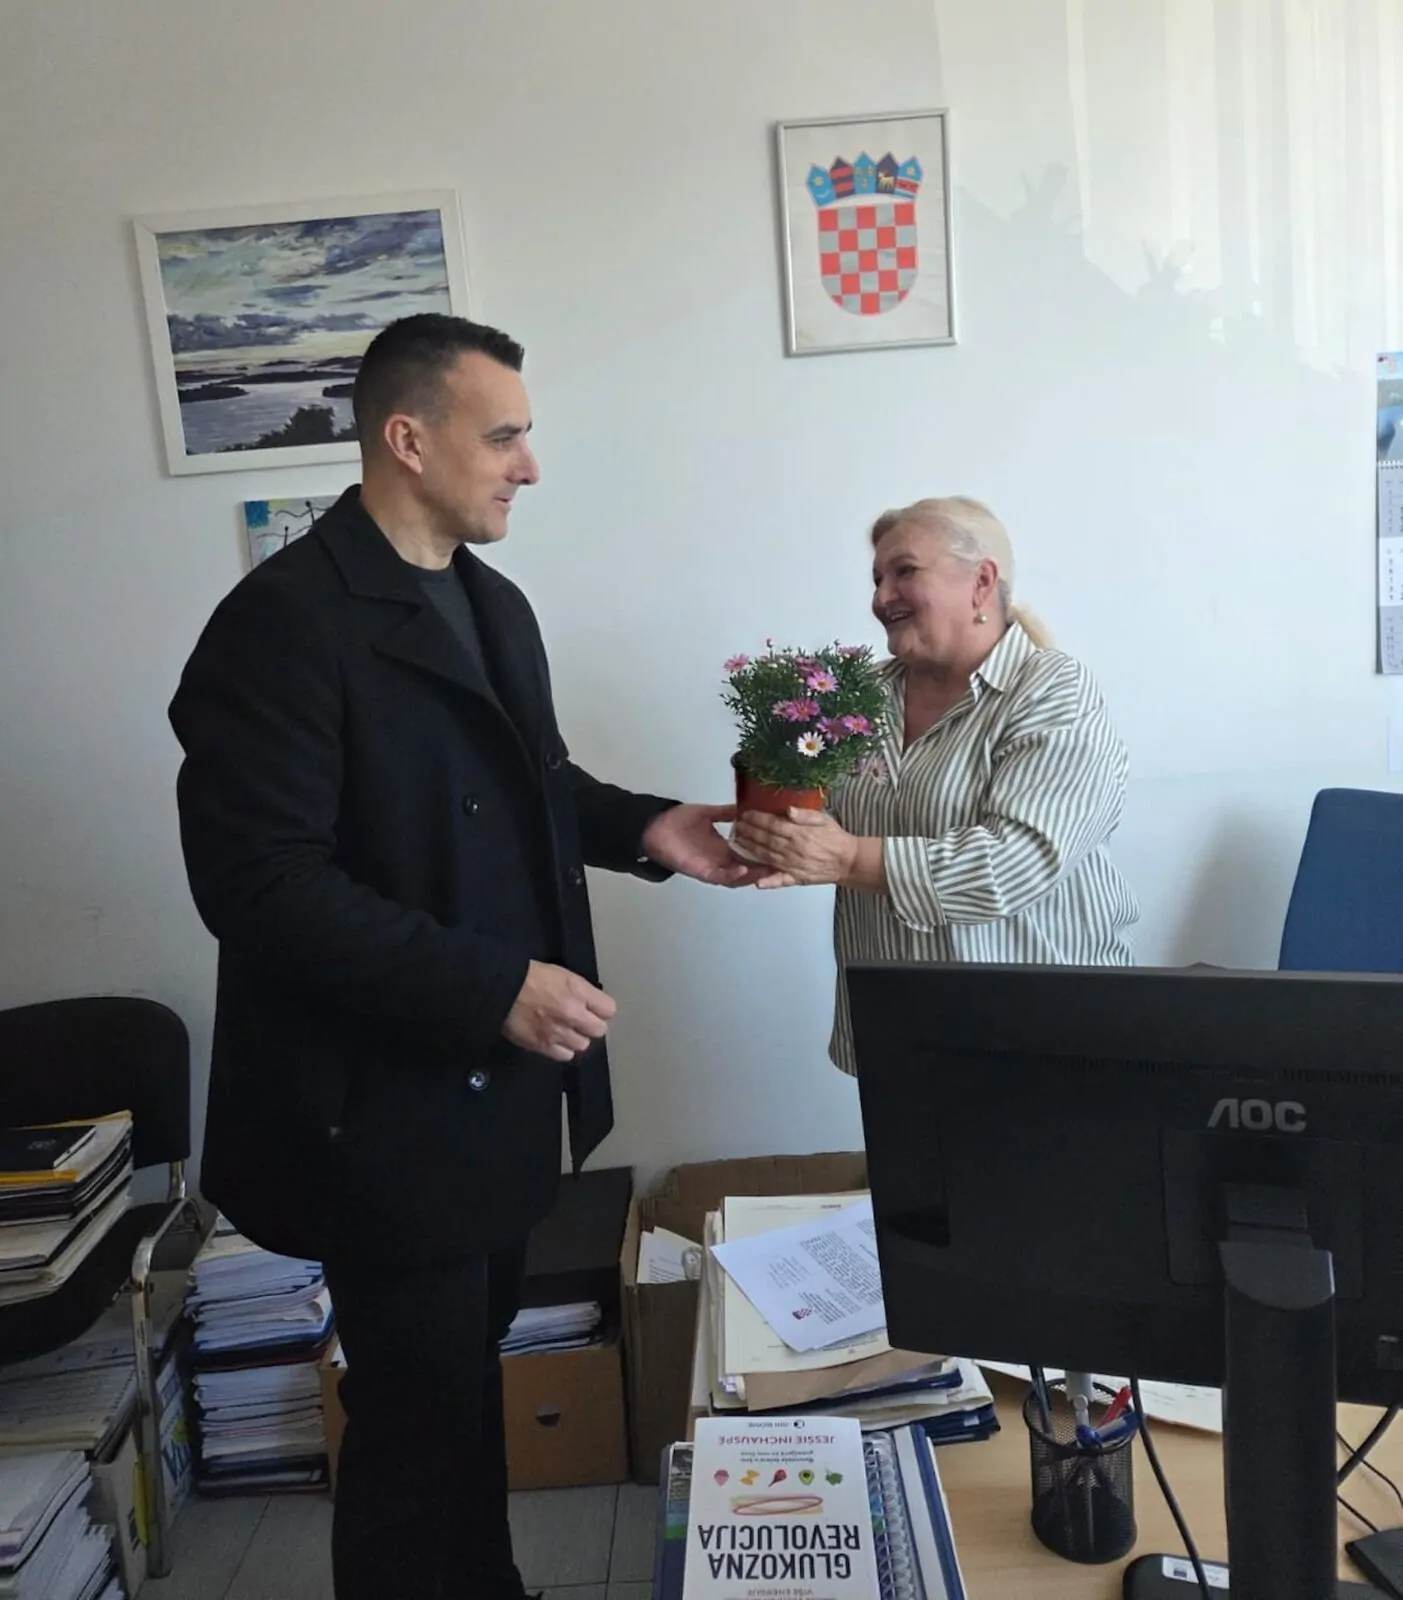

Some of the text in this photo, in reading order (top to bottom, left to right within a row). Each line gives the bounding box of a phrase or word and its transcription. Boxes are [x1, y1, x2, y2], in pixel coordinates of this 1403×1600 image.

[1207, 1098, 1307, 1132] AOC
[718, 1435, 835, 1446] JESSIE INCHAUSPÉ
[698, 1525, 860, 1550] REVOLUCIJA
[708, 1553, 851, 1579] GLUKOZNA
